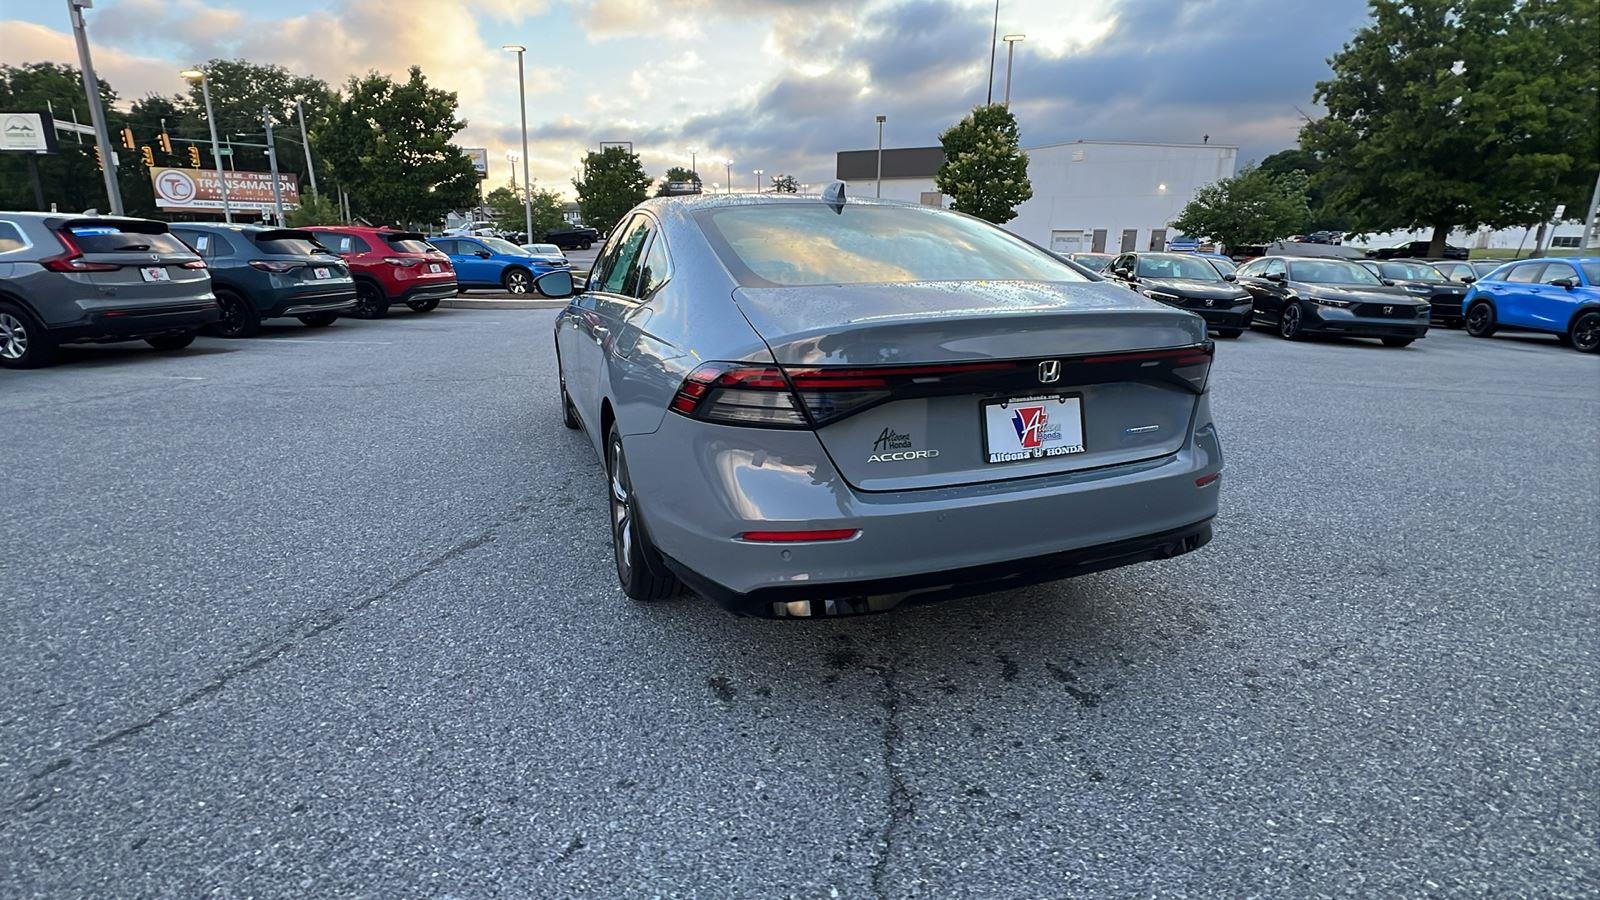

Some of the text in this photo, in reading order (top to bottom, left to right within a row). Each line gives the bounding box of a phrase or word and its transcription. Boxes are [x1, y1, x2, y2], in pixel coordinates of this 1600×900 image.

[889, 440, 912, 449] Honda
[867, 449, 940, 463] ACCORD
[989, 451, 1031, 463] Altoona
[1046, 445, 1085, 456] HONDA
